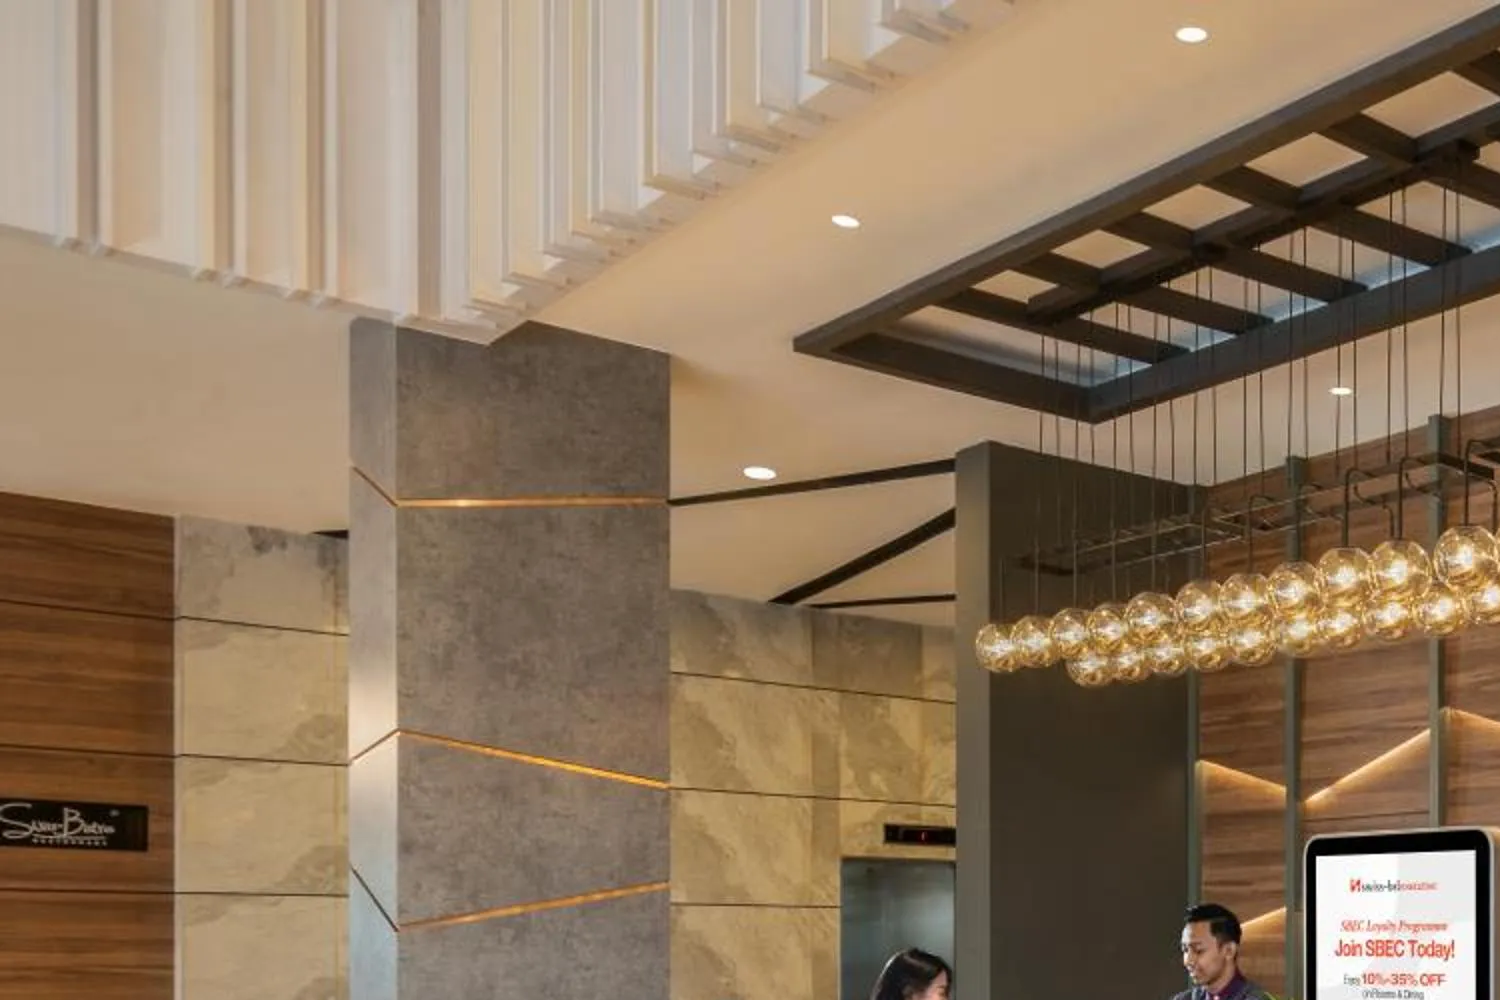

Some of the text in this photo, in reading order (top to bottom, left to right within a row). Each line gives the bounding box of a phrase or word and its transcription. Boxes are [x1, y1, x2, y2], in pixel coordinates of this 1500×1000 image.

[1334, 939, 1455, 961] Join SBEC Today!
[1420, 973, 1446, 986] OFF
